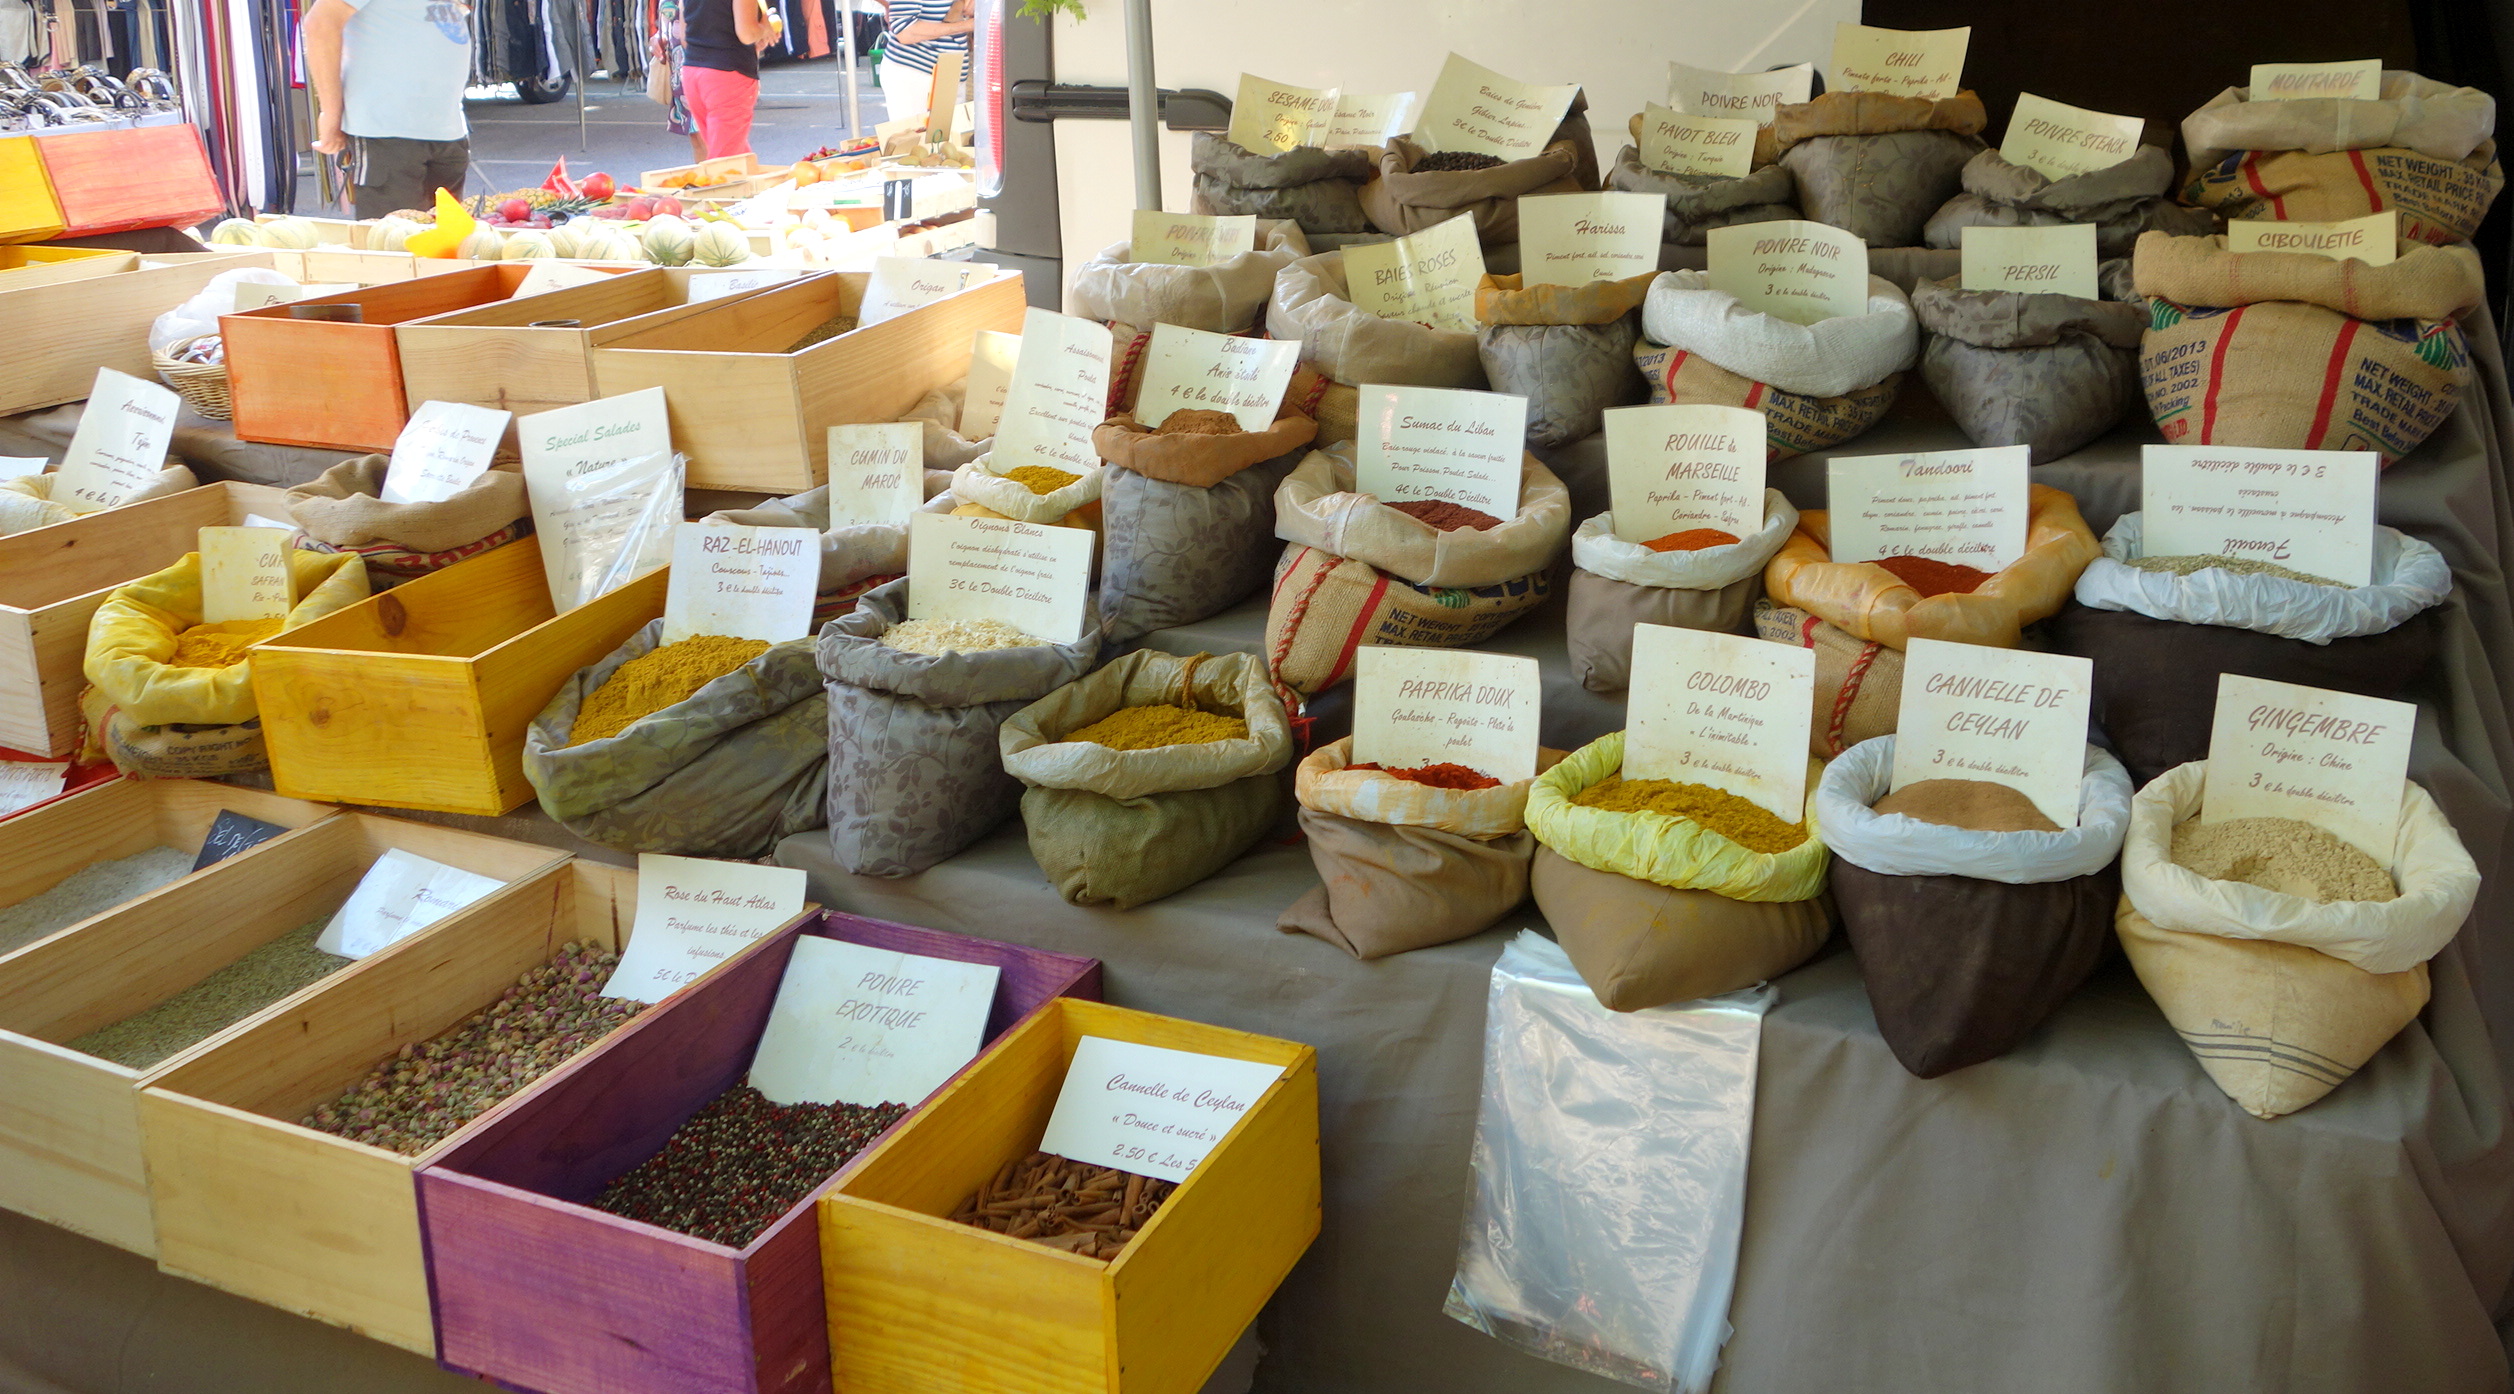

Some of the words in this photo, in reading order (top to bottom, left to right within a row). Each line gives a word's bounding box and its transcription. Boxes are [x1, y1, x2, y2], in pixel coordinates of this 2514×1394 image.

[1885, 52, 1925, 67] CHILI
[1842, 67, 1870, 80] Piments
[2268, 70, 2366, 91] MOUTARDE
[1266, 91, 1317, 112] SESAME
[1479, 86, 1502, 101] Baies
[1701, 91, 1748, 110] POIVRE
[1751, 92, 1783, 108] NOIR
[1657, 121, 1704, 143] PAVOT
[1702, 130, 1741, 145] BLEU
[2024, 118, 2083, 144] POIVRE
[2080, 133, 2128, 154] STEACK
[1663, 145, 1687, 159] Origine
[2027, 150, 2037, 160] 3
[2377, 155, 2403, 168] NET
[2406, 158, 2453, 179] WEIGHT
[1574, 219, 1627, 235] Harissa
[2257, 229, 2364, 249] CIBOULETTE
[1171, 247, 1197, 260] Origine
[1545, 252, 1570, 262] Piment
[1753, 237, 1811, 256] POIVRE
[1810, 240, 1842, 261] NOIR
[1374, 262, 1413, 286] BAIES
[1418, 248, 1457, 276] ROSES
[1593, 269, 1614, 278] Cumin
[1757, 262, 1786, 276] Origine
[2004, 265, 2061, 281] PERSIL
[911, 279, 945, 295] Origan
[1425, 278, 1459, 293] Réunion
[1765, 283, 1775, 296] 3
[1221, 337, 1256, 355] Badiane
[1078, 369, 1098, 384] Poulet
[1206, 362, 1233, 379] Anis
[1234, 367, 1259, 382] étoilé
[2360, 357, 2390, 380] NET
[2389, 372, 2433, 405] WEIGHT
[1170, 384, 1181, 396] 4
[1195, 386, 1208, 401] le
[2171, 378, 2198, 394] 2002
[2353, 373, 2384, 399] MAX.
[1028, 406, 1058, 420] Excellent
[2351, 390, 2398, 424] TRADE
[1400, 416, 1443, 431] Sumac
[1447, 420, 1462, 432] du
[1465, 420, 1496, 436] Liban
[1764, 407, 1813, 433] TRADE
[545, 429, 590, 452] Special
[593, 421, 642, 443] Salades
[1766, 421, 1792, 438] Best
[1382, 442, 1400, 451] Baie
[1400, 445, 1421, 454] rouge
[1665, 434, 1728, 452] ROUILLE
[1728, 438, 1738, 453] de
[850, 449, 891, 466] CUMIN
[892, 449, 909, 465] DU
[576, 460, 616, 475] Nature
[1391, 462, 1410, 472] Pour
[1665, 462, 1742, 482] MARSEILLE
[1900, 459, 1974, 477] Tandoori
[2191, 460, 2240, 474] décilitre
[2243, 462, 2283, 476] double
[2286, 465, 2298, 476] le
[2315, 465, 2327, 478] 3
[861, 473, 902, 491] MAROC
[1424, 485, 1457, 500] Double
[1647, 490, 1681, 506] Paprika
[1692, 489, 1718, 502] Piment
[2238, 489, 2280, 499] crustacés
[1672, 508, 1712, 521] Coriandre
[2290, 510, 2346, 526] Accompagne
[970, 518, 1010, 534] Oignons
[1013, 522, 1044, 538] Blancs
[981, 544, 1021, 560] déshydraté
[1918, 543, 1955, 556] double
[2223, 539, 2290, 560] Fenouil
[711, 562, 751, 576] Couscous
[948, 559, 998, 573] remplacement
[716, 581, 724, 594] 3
[948, 578, 967, 591] 3€
[968, 581, 979, 592] le
[980, 581, 1014, 597] Double
[1389, 608, 1418, 625] NET
[1418, 617, 1462, 632] WEIGHT
[1379, 621, 1408, 638] MAX.
[1409, 629, 1446, 642] RETAIL
[1770, 627, 1796, 642] 2002
[1398, 679, 1472, 702] PAPRIKA
[1475, 685, 1515, 709] DOUX
[1686, 670, 1771, 701] COLOMBO
[1925, 672, 2034, 704] CANNELLE
[2033, 687, 2069, 709] DE
[1446, 712, 1479, 730] Ragoûts
[1486, 716, 1506, 731] Plats
[1686, 702, 1701, 715] De
[1703, 704, 1713, 717] la
[1716, 707, 1765, 729] Martinique
[2248, 704, 2387, 745] GINGEMBRE
[1946, 711, 2030, 741] CEYLAN
[1445, 734, 1473, 749] poulet
[1699, 727, 1749, 746] L'inimitable
[1680, 751, 1691, 765] 3
[1710, 761, 1732, 773] double
[1932, 749, 1946, 764] 3
[1967, 760, 1993, 772] double
[2260, 741, 2304, 764] Origine
[2319, 752, 2353, 771] Chine
[2248, 772, 2263, 788] 3
[2285, 785, 2314, 799] double
[664, 885, 690, 900] Rose
[693, 890, 707, 903] du
[710, 889, 741, 907] Haut
[742, 894, 777, 910] Atlas
[665, 917, 703, 934] Parfume
[705, 923, 718, 933] les
[720, 924, 738, 936] thés
[672, 972, 683, 983] le
[857, 971, 925, 997] POIVRE
[835, 999, 927, 1031] EXOTIQUE
[838, 1036, 853, 1049] 2
[1105, 1073, 1169, 1099] Cannelle
[1172, 1087, 1189, 1102] de
[1194, 1089, 1246, 1113] Ceylan
[1122, 1113, 1159, 1133] Douce
[1161, 1124, 1175, 1135] et
[1176, 1128, 1206, 1142] sucré
[1112, 1143, 1146, 1161] 2.50
[1147, 1152, 1157, 1164] €
[1158, 1153, 1183, 1170] Les
[1185, 1159, 1199, 1172] 5
